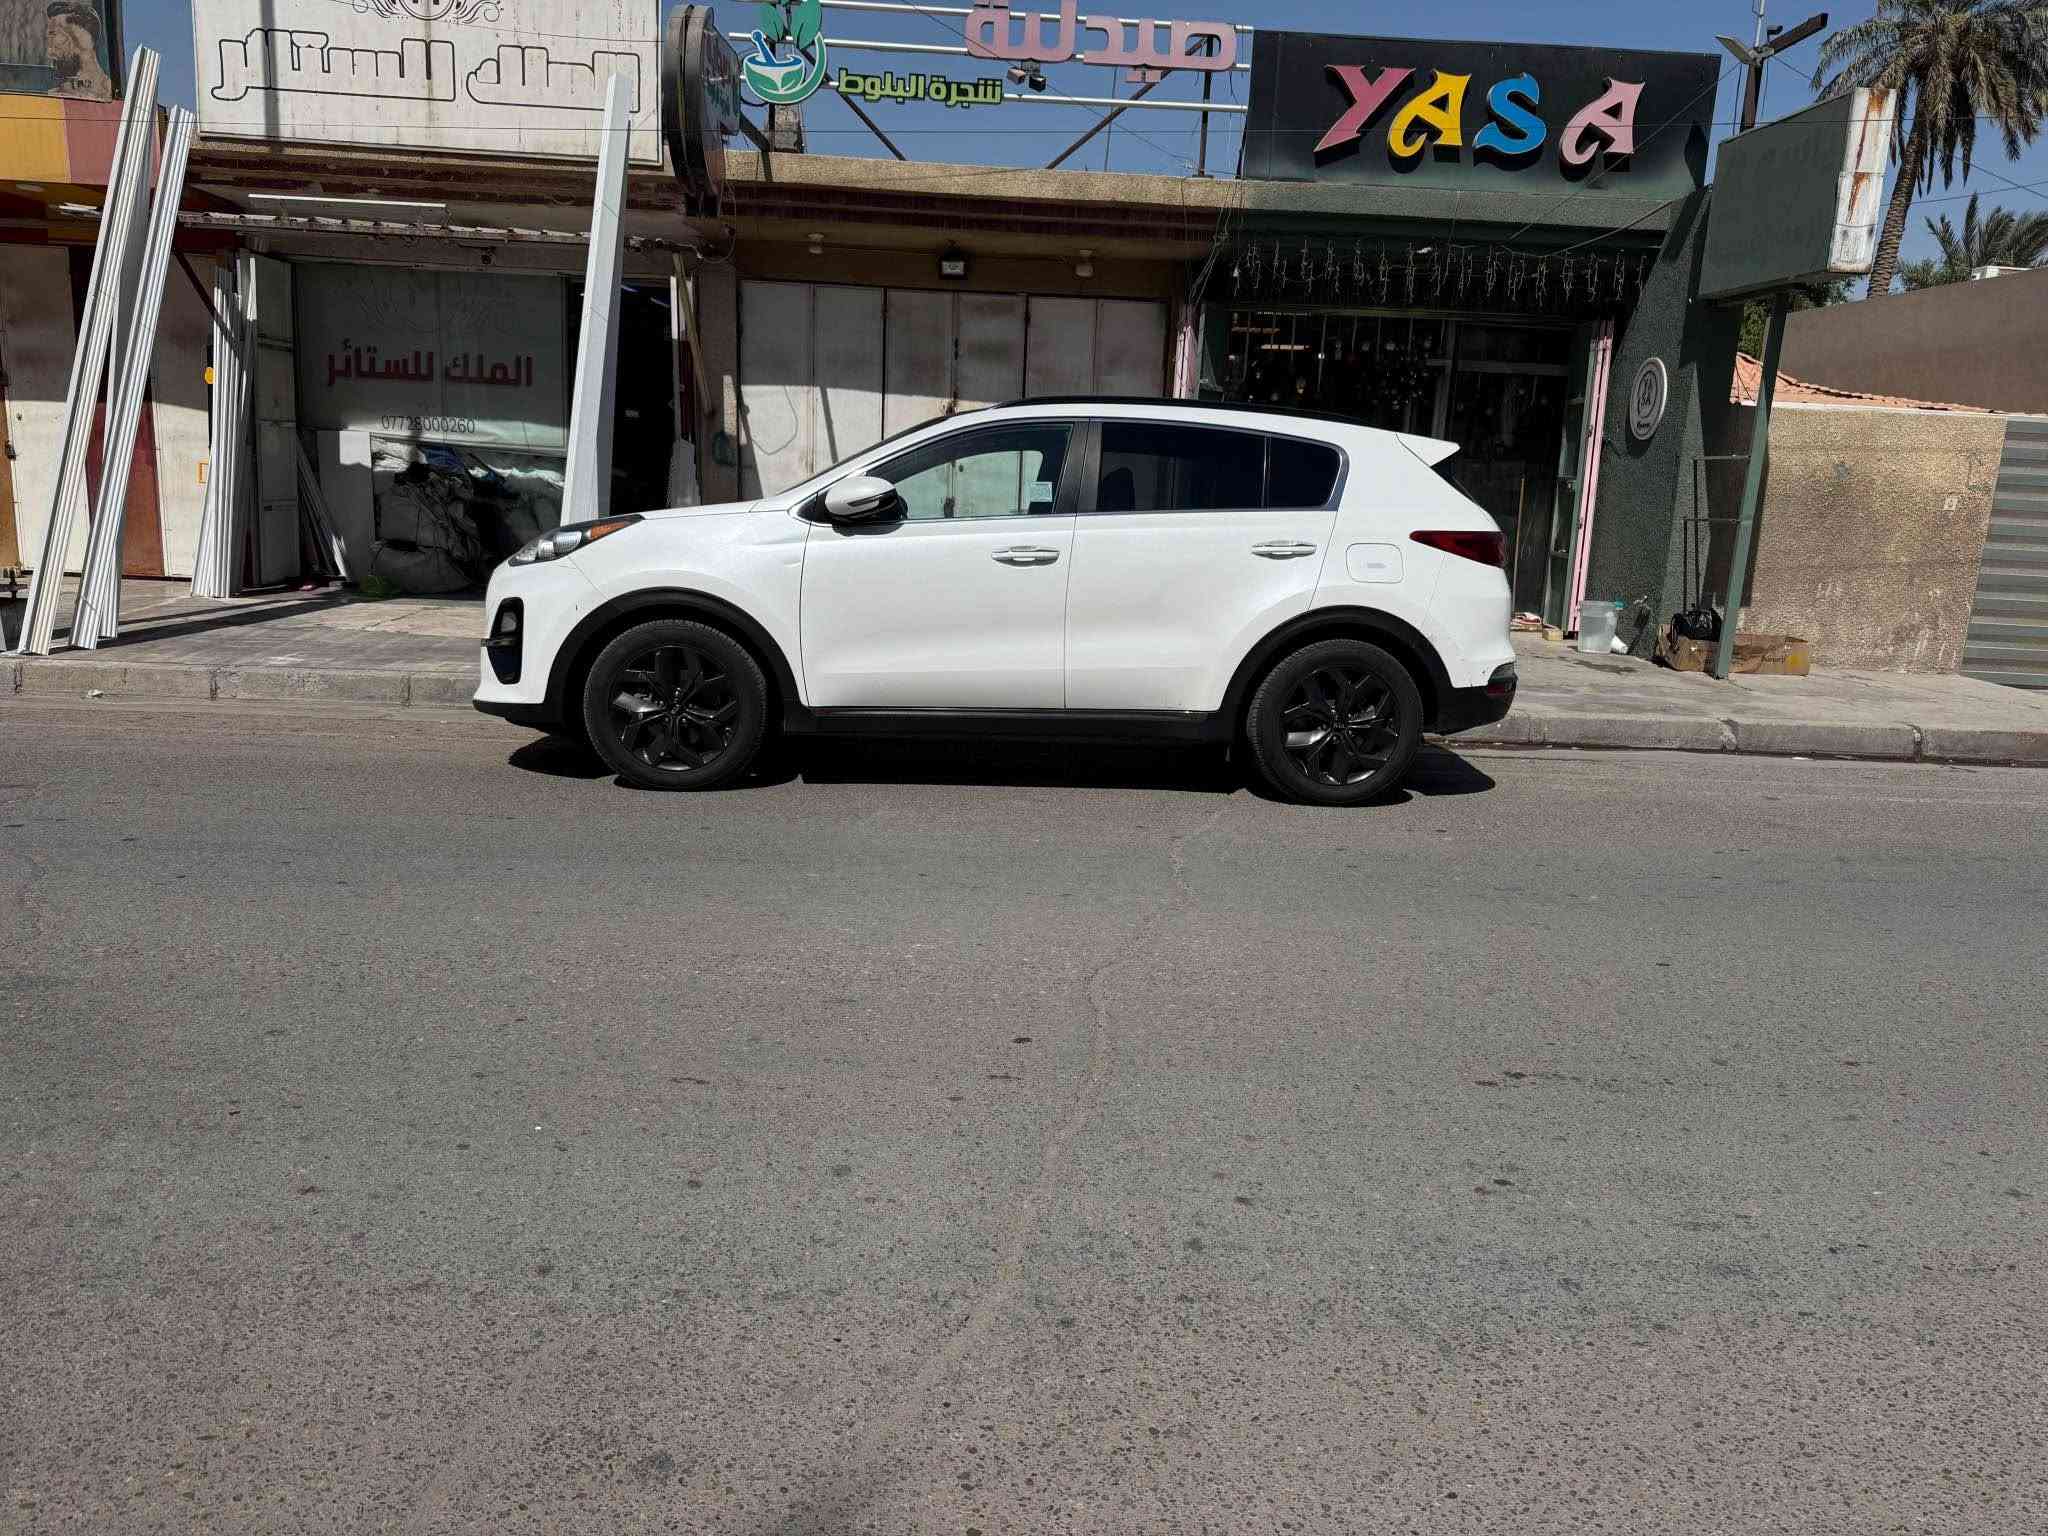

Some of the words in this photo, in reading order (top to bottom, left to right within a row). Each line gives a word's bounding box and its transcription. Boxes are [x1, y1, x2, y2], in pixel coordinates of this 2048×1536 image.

[837, 67, 926, 104] البلوط
[929, 75, 1003, 108] شجرة
[1312, 64, 1647, 166] YASA
[445, 353, 533, 387] الملك
